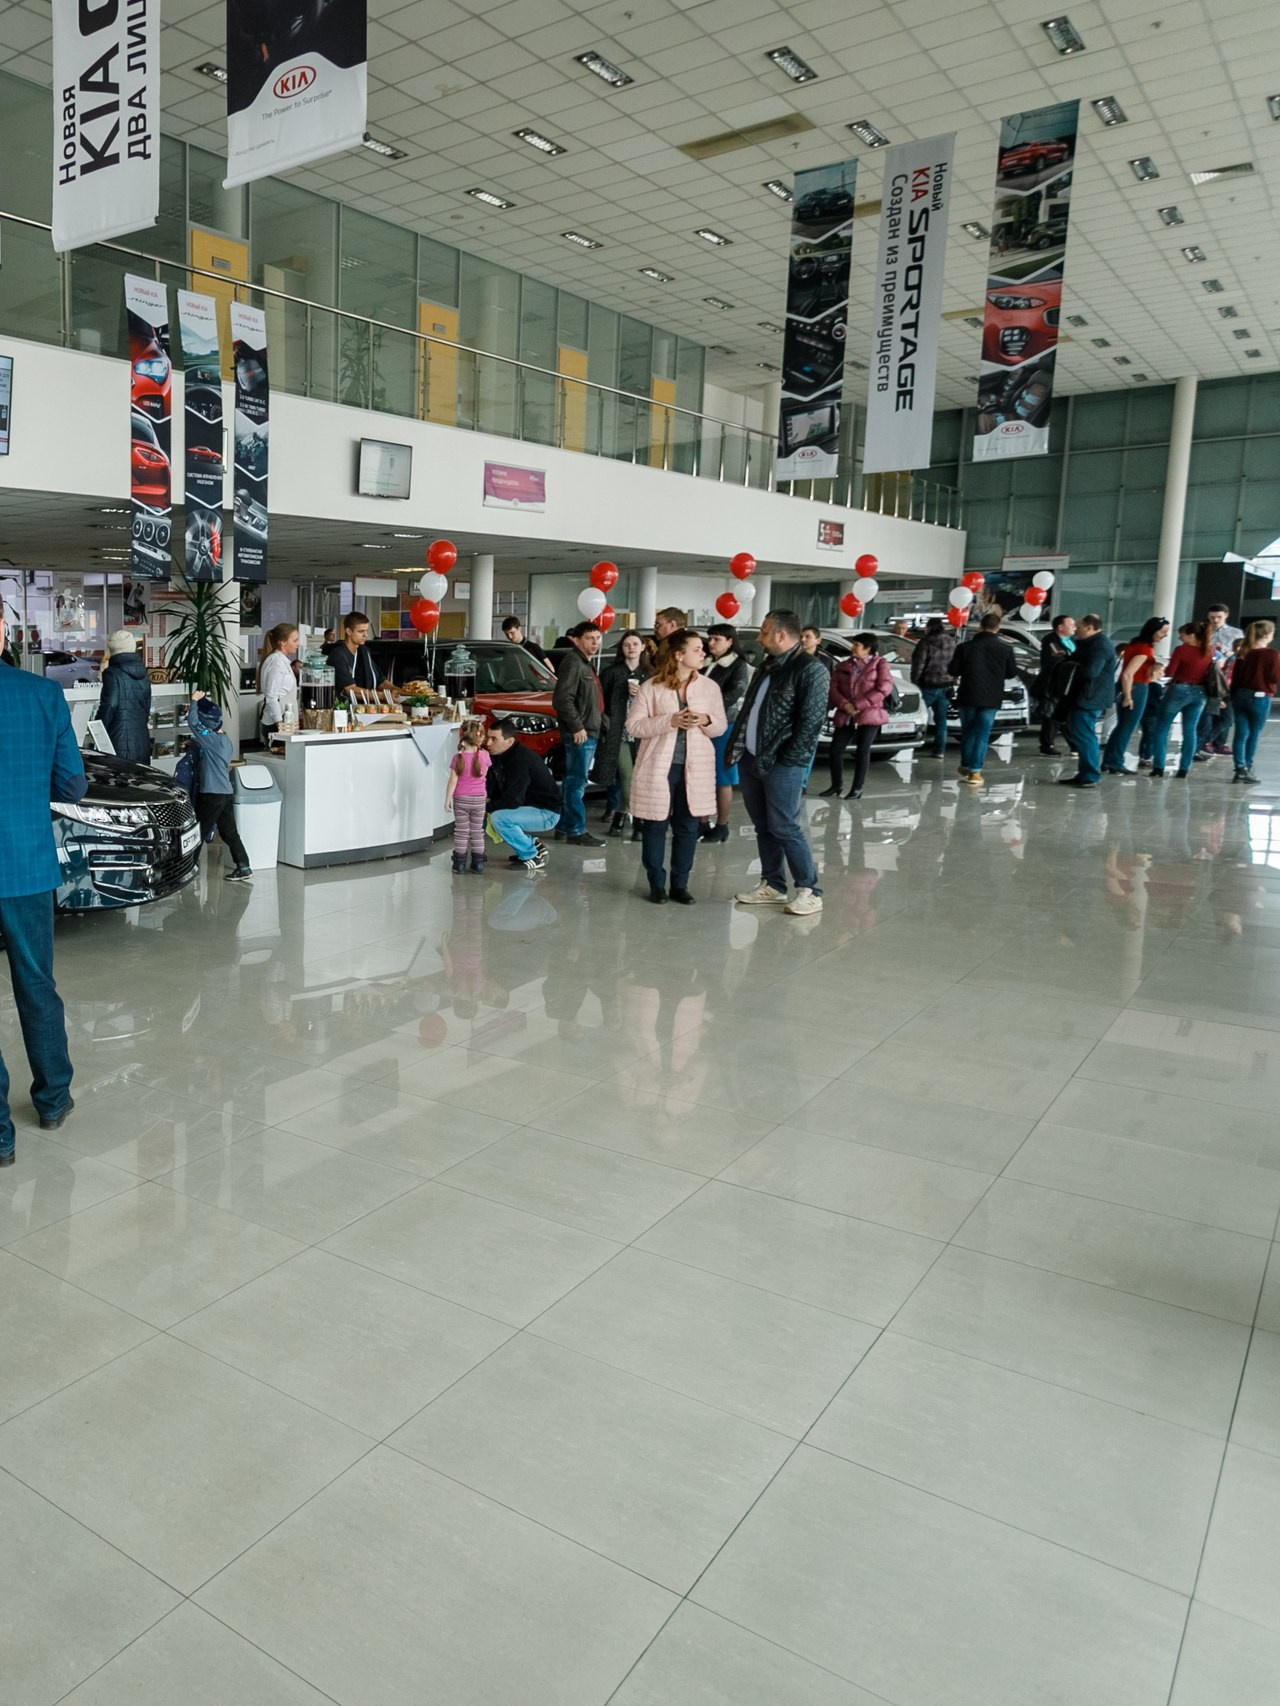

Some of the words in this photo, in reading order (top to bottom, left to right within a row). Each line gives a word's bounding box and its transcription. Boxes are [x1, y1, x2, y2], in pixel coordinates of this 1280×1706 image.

[79, 41, 120, 176] KIA
[261, 112, 273, 121] The
[273, 104, 293, 117] Power
[294, 100, 301, 109] to
[280, 71, 309, 95] KIA
[59, 84, 77, 186] Новая
[127, 85, 152, 161] ДВА
[887, 173, 908, 240] Создан
[911, 166, 931, 203] KIA
[931, 162, 948, 212] Новый
[886, 245, 899, 265] из
[877, 270, 897, 393] преимуществ
[895, 206, 930, 413] SPORTAGE
